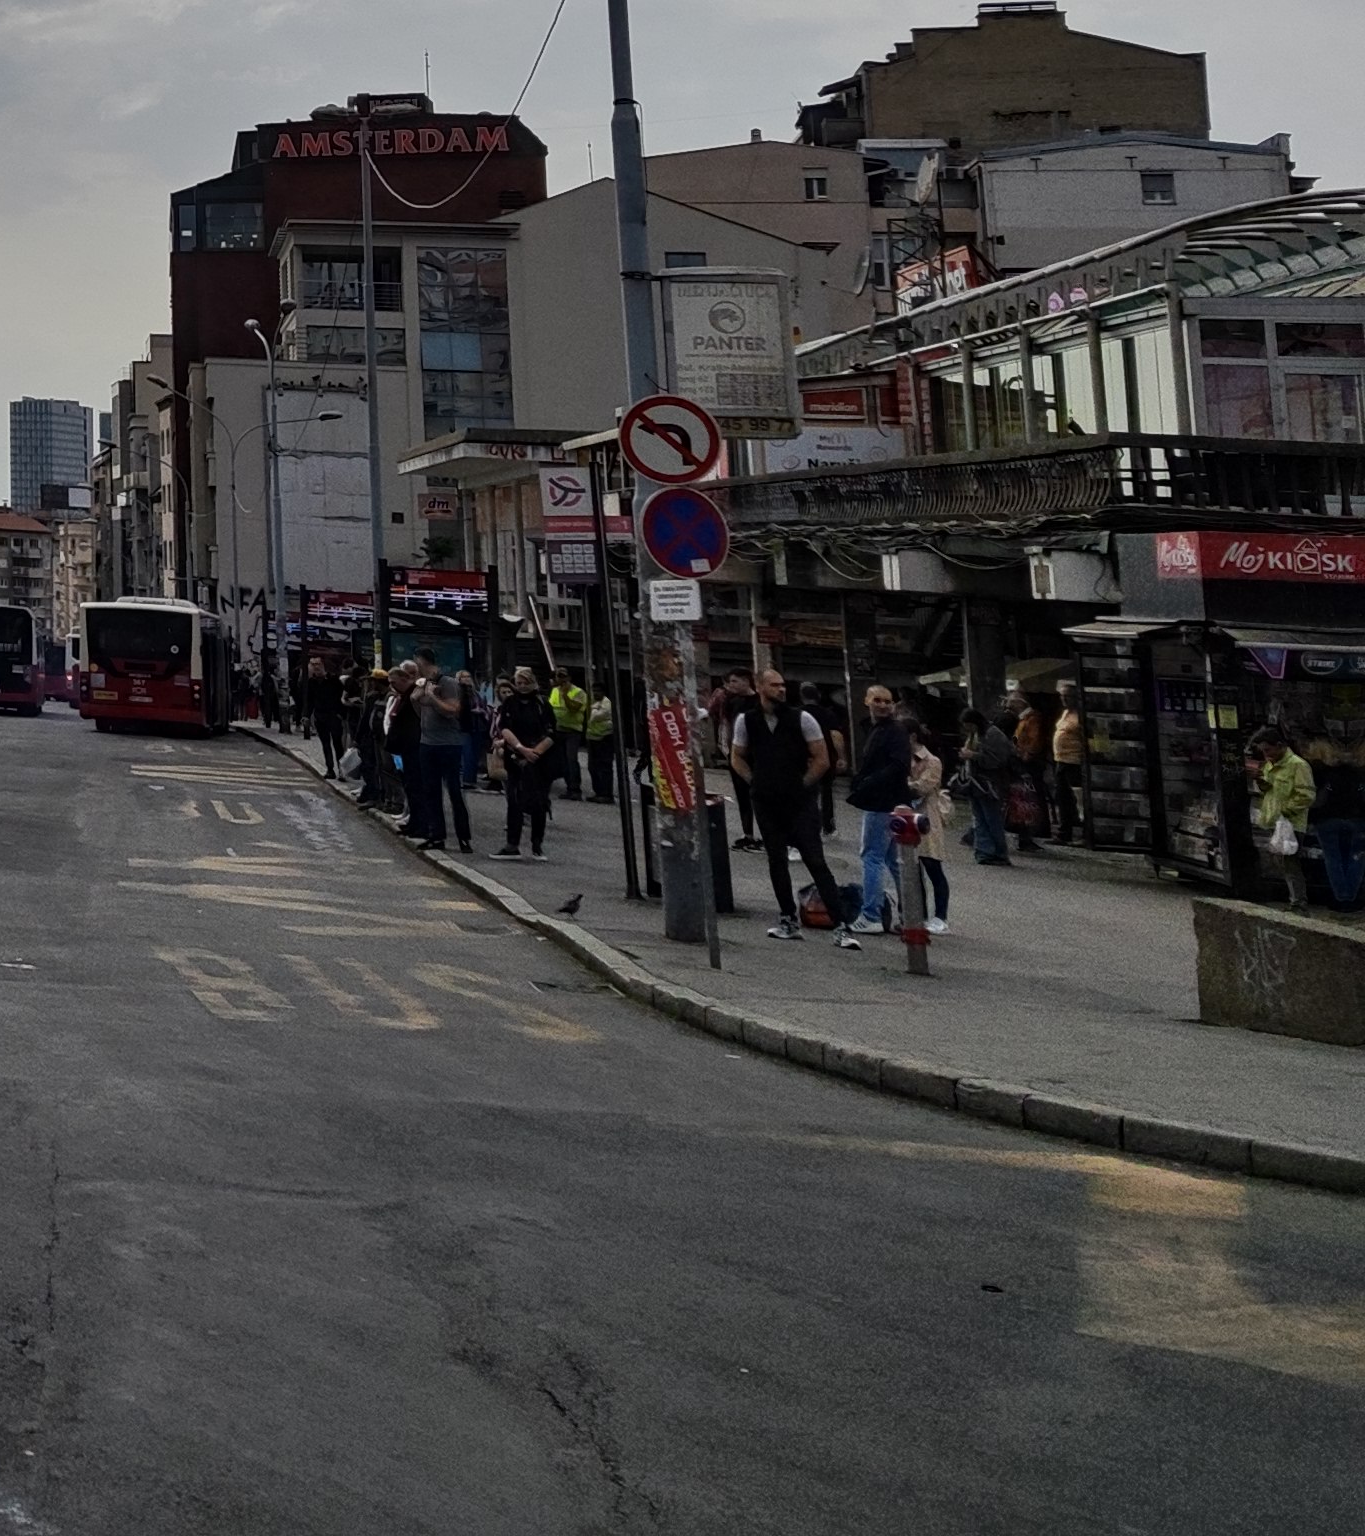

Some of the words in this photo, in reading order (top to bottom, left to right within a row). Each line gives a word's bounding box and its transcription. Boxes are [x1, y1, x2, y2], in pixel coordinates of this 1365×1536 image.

[272, 126, 510, 158] AMSTERDAM
[693, 335, 768, 351] PANTER
[749, 418, 770, 431] 99
[428, 497, 449, 509] dm
[153, 946, 605, 1044] BUS
